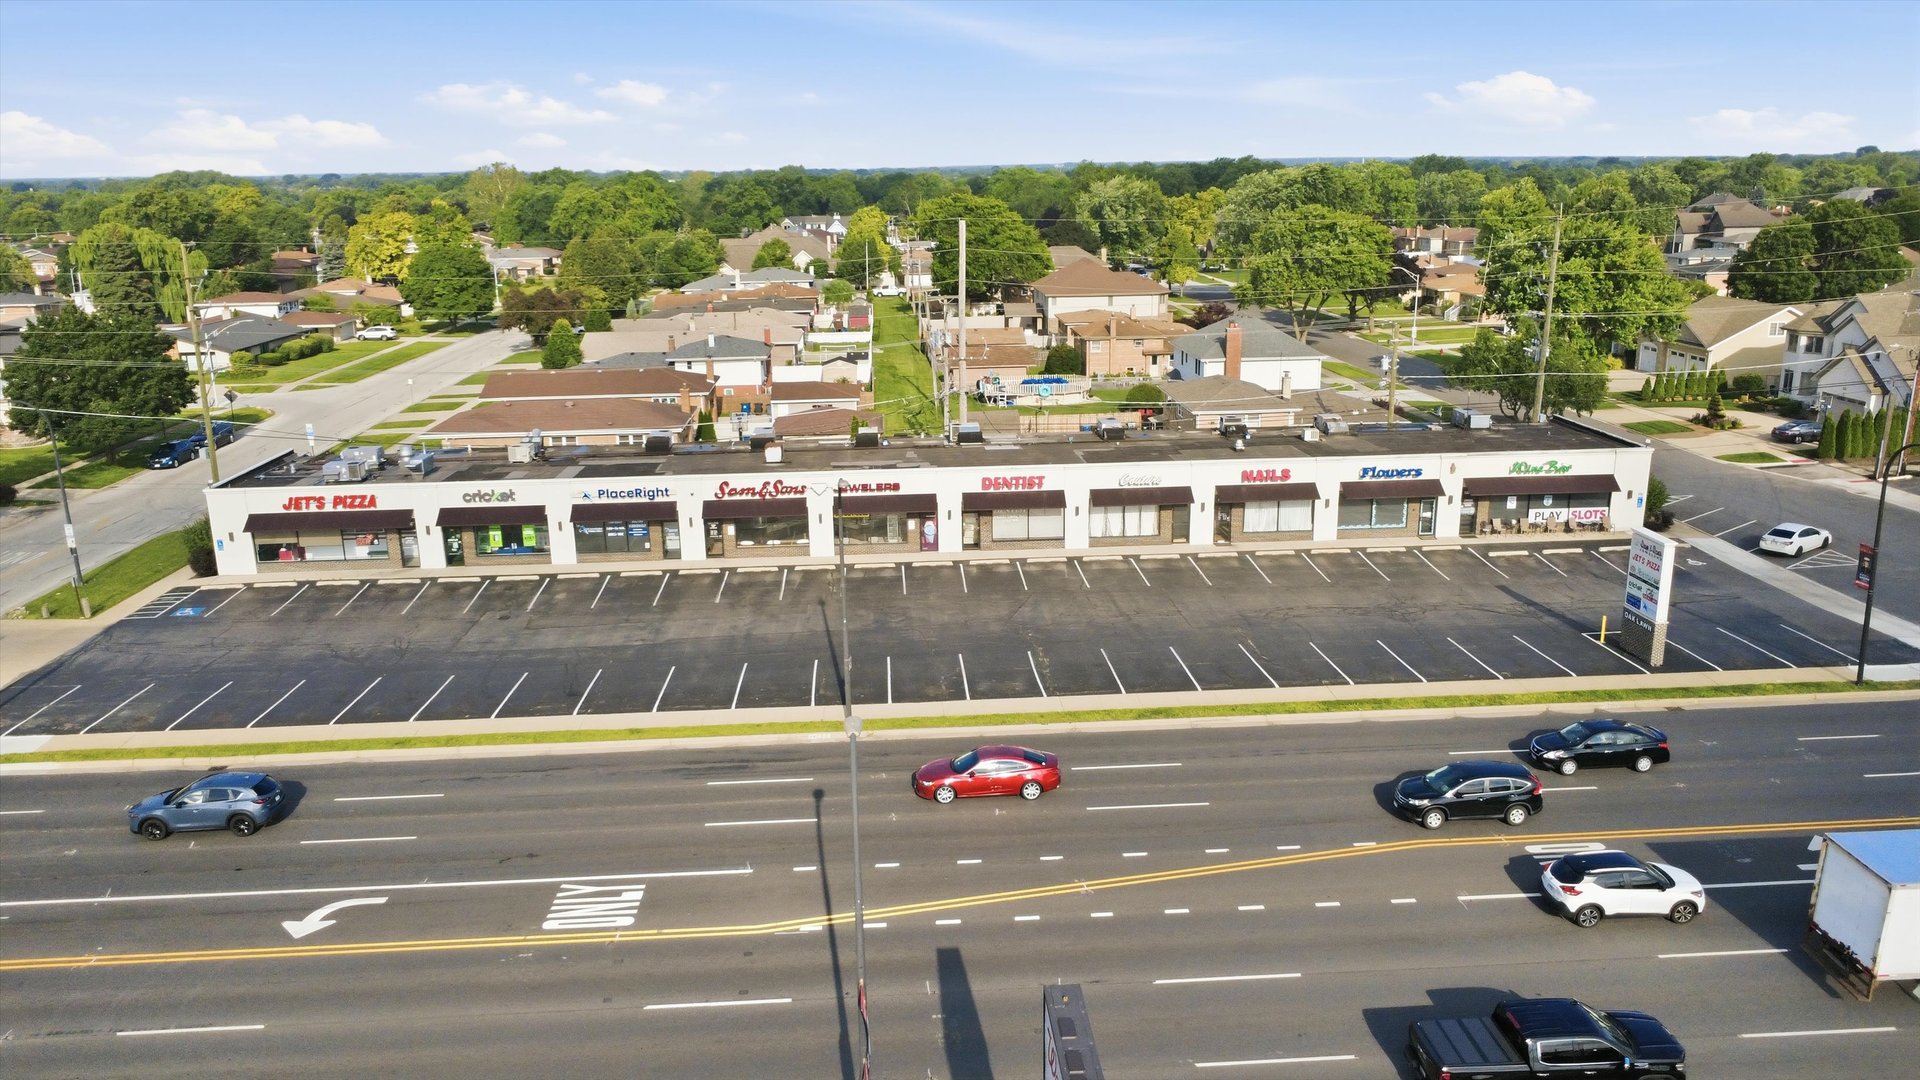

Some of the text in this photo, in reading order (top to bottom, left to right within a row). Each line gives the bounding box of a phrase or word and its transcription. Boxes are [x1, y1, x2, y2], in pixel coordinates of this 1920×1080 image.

[1241, 468, 1291, 483] NAILS
[1360, 466, 1423, 479] Flowers
[833, 482, 901, 493] WELERS
[981, 475, 1045, 491] DENTIST
[462, 489, 516, 503] cricket
[597, 487, 670, 501] PlaceRight
[282, 494, 378, 511] JET'S PIZZA
[1534, 510, 1606, 521] PLAY SLOTS
[1624, 611, 1636, 623] OAK
[542, 884, 646, 929] ONLY
